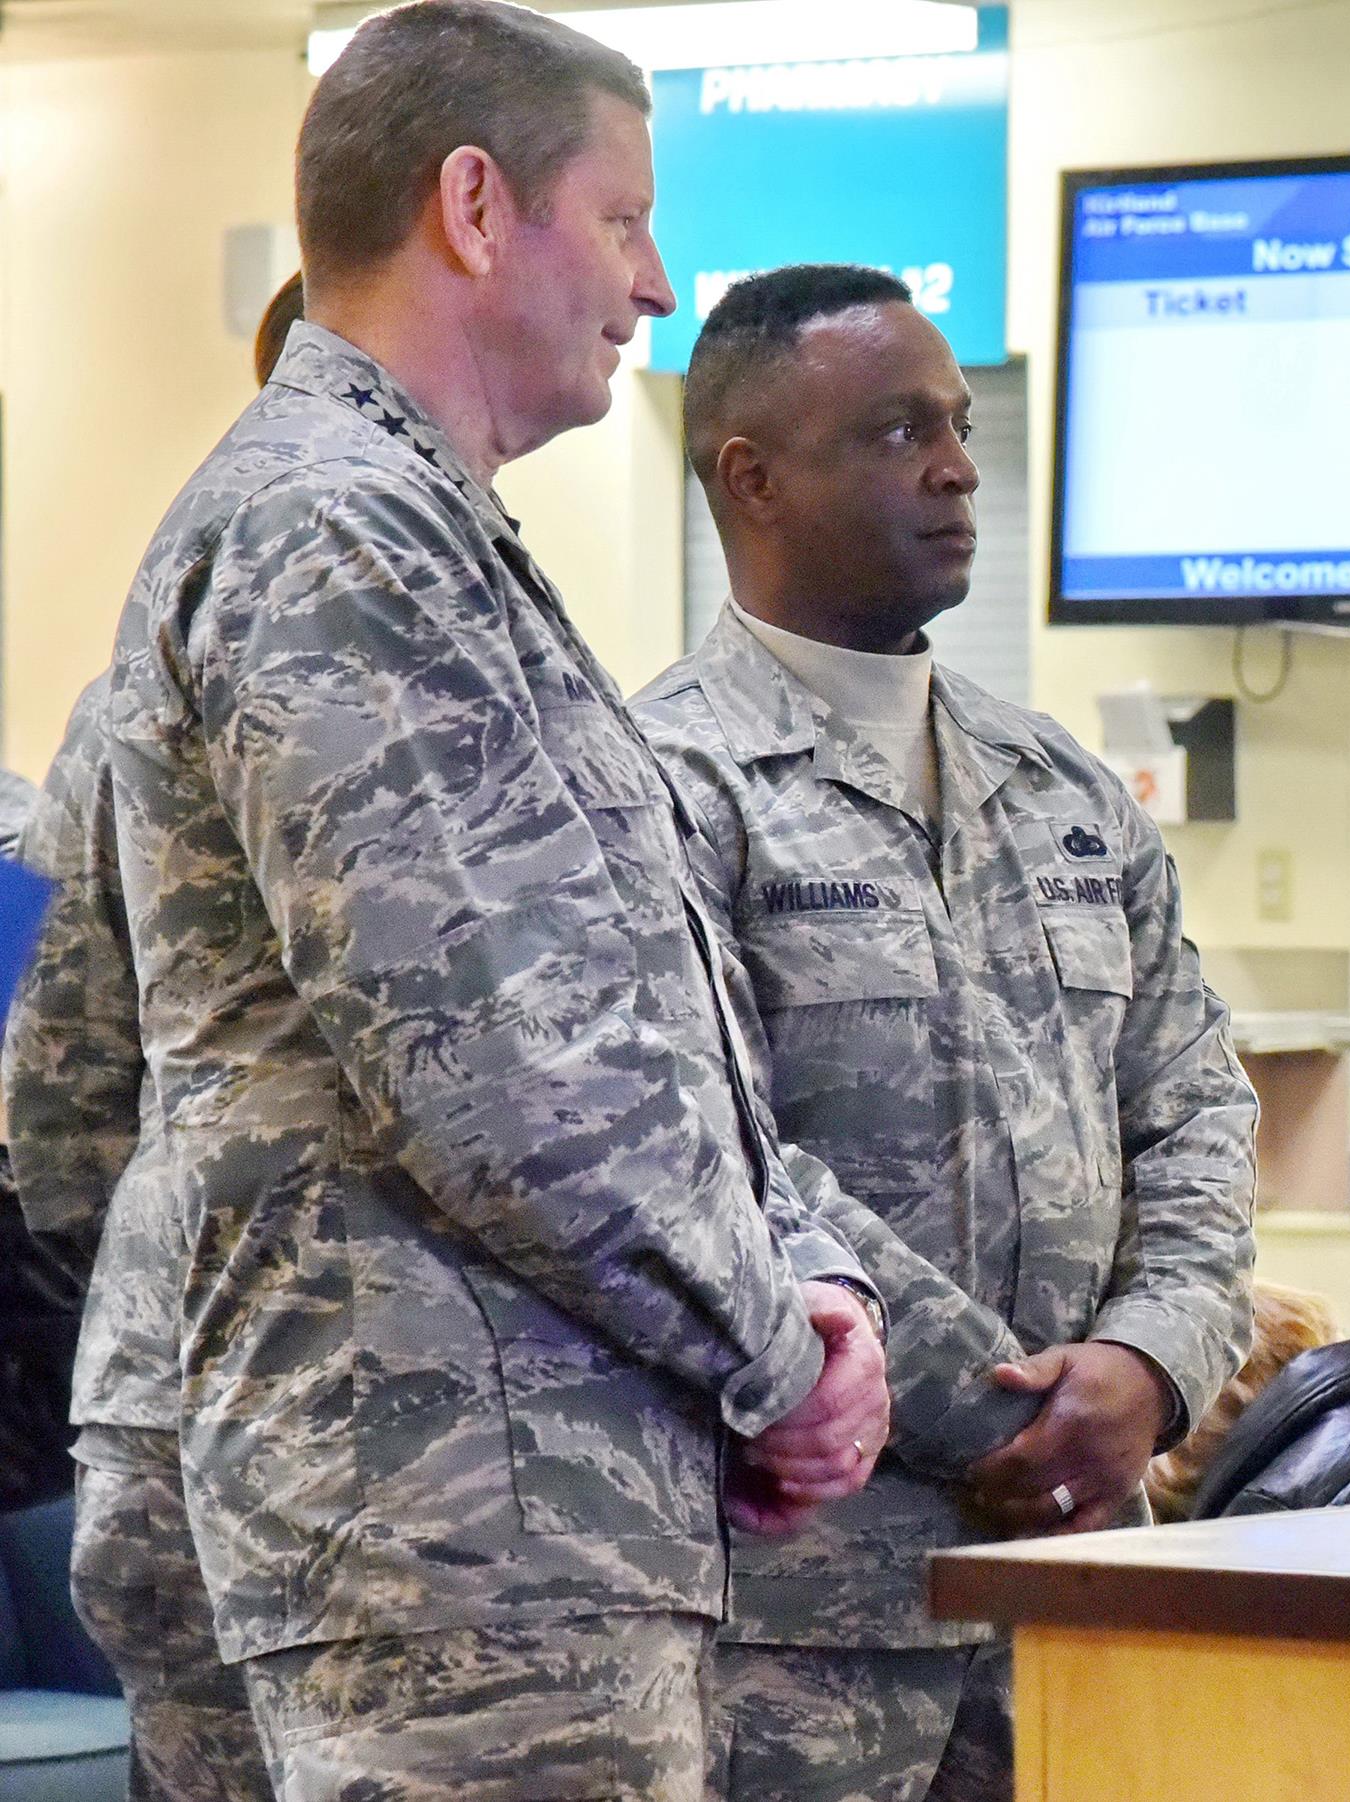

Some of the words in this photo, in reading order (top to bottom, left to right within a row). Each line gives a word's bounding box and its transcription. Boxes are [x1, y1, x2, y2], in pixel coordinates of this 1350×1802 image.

[1252, 237, 1336, 272] Now
[1144, 287, 1248, 317] Ticket
[762, 881, 880, 914] WILLIAMS
[1036, 876, 1075, 902] U.S.
[1073, 876, 1108, 904] AIR
